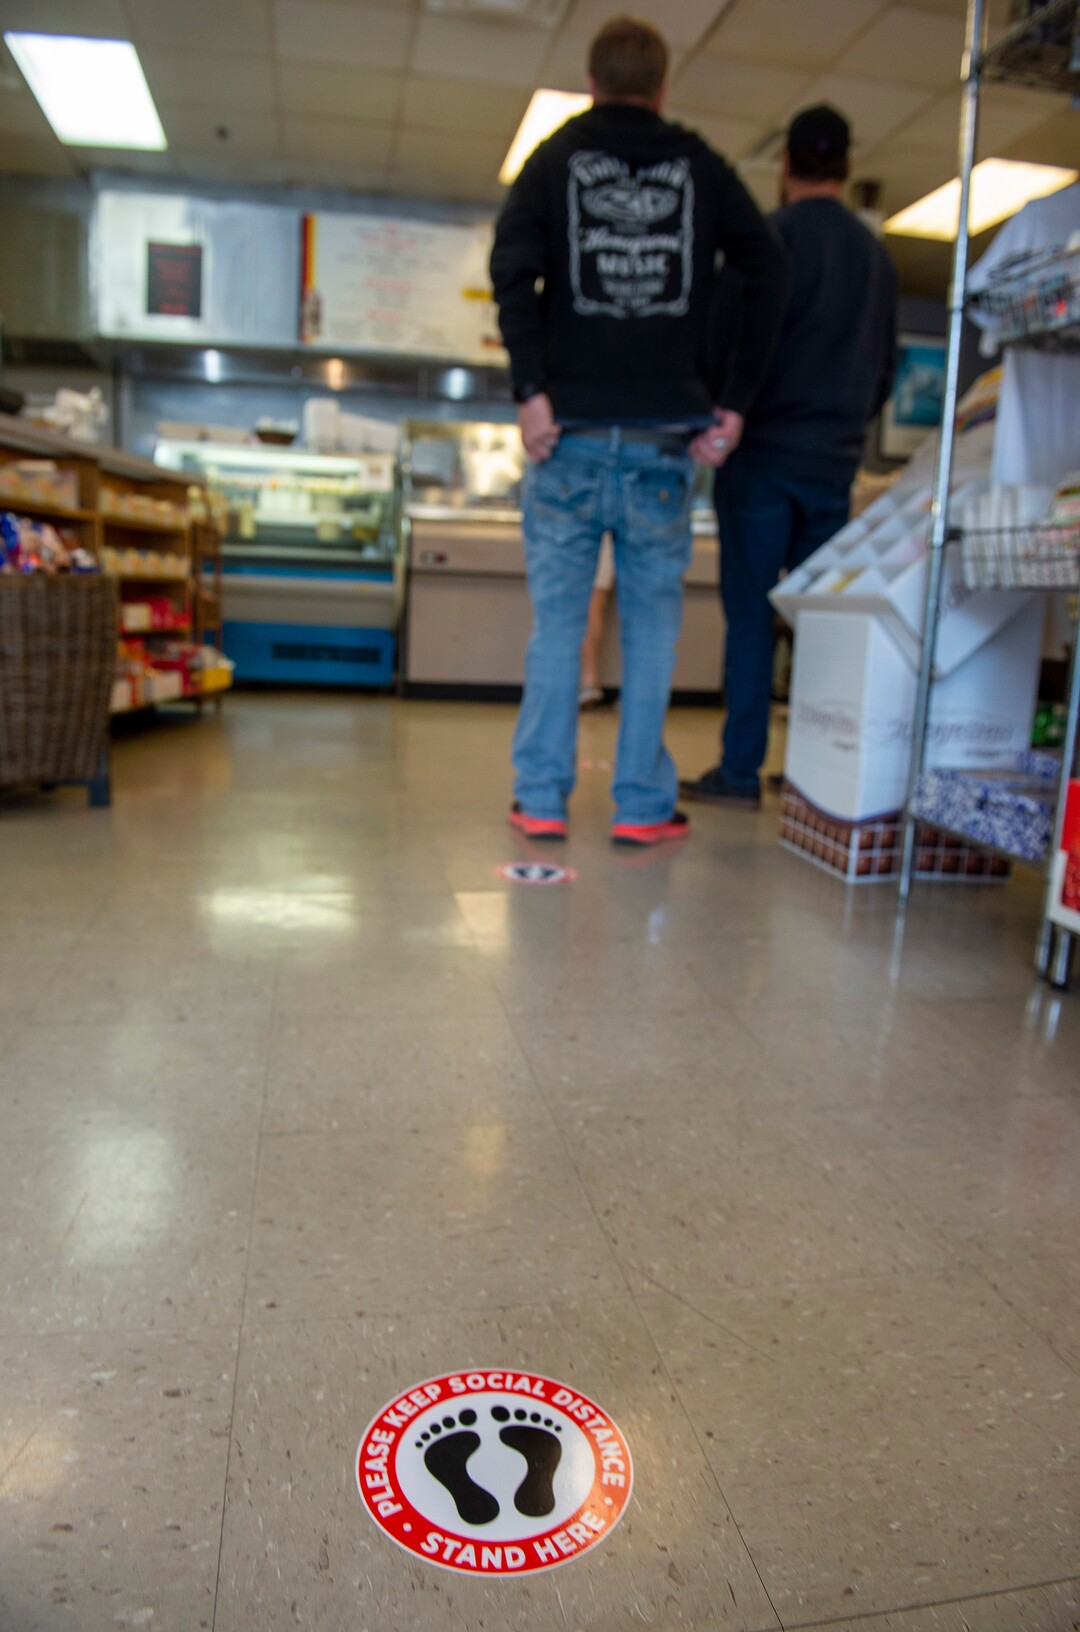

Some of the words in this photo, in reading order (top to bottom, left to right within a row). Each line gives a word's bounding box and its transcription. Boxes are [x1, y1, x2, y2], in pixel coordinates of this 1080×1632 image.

[365, 1428, 402, 1518] PLEASE
[384, 1384, 442, 1429] KEEP
[448, 1373, 547, 1398] SOCIAL
[551, 1389, 625, 1489] DISTANCE
[420, 1532, 527, 1569] STAND
[532, 1510, 606, 1562] HERE
